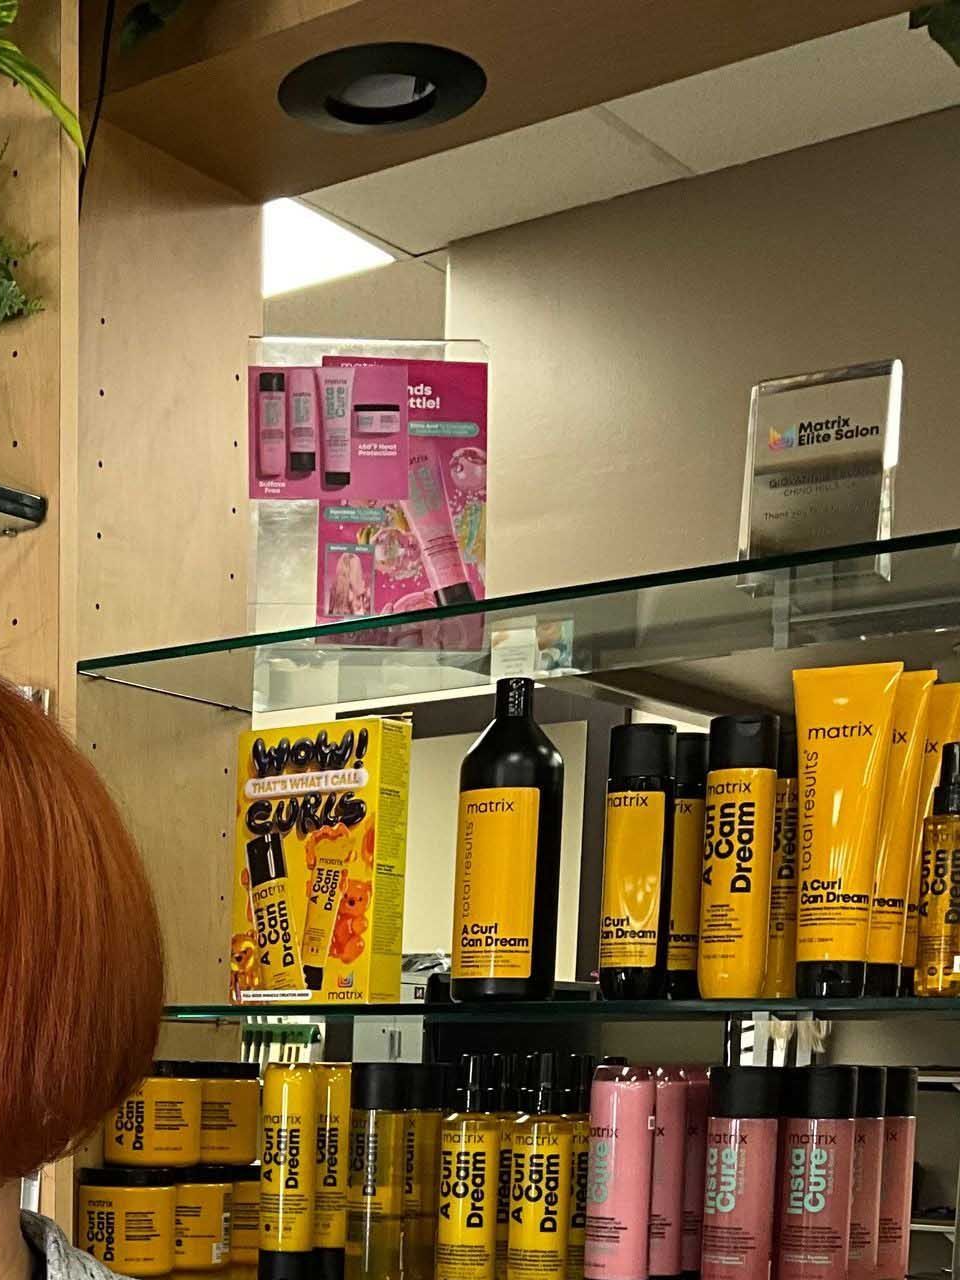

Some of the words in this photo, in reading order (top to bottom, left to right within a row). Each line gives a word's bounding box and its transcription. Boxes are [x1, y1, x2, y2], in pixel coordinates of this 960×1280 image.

[408, 397, 441, 409] ttle!
[798, 416, 851, 434] Matrix
[797, 432, 832, 447] Elite
[834, 425, 880, 442] Salon
[251, 727, 369, 778] WOW!
[807, 722, 874, 742] matrix
[289, 776, 323, 792] WHAT
[330, 771, 360, 787] CALL
[804, 750, 819, 827] results
[245, 791, 368, 841] CURLS
[466, 799, 515, 814] matrix
[713, 801, 737, 859] Can
[464, 820, 474, 875] results
[729, 801, 756, 894] Dream
[322, 868, 333, 895] Can
[323, 870, 341, 911] Dream
[800, 891, 824, 905] Can
[826, 891, 869, 905] Dream
[801, 880, 808, 892] A
[810, 878, 842, 891] Curl
[267, 902, 278, 945] Can
[276, 900, 296, 968] Dream
[460, 935, 487, 948] Can
[489, 936, 529, 948] Dream
[461, 925, 470, 936] A
[471, 922, 498, 936] Curl
[615, 928, 657, 940] Dream
[327, 989, 364, 1002] matrix
[123, 1100, 135, 1132] Can
[132, 1100, 145, 1151] Dream
[788, 1131, 838, 1147] matrix
[262, 1127, 274, 1165] Curl
[284, 1127, 301, 1190] Dream
[322, 1126, 339, 1188] Dream
[440, 1150, 453, 1198] Curl
[451, 1150, 471, 1200] Can
[466, 1150, 487, 1229] Dream
[511, 1153, 525, 1202] Curl
[524, 1153, 545, 1203] Can
[539, 1153, 561, 1233] Dream
[590, 1140, 610, 1205] Cure
[715, 1148, 738, 1214] Cure
[786, 1147, 807, 1216] Insta
[803, 1148, 829, 1214] Cure
[95, 1211, 105, 1242] Can
[103, 1211, 115, 1262] Dream
